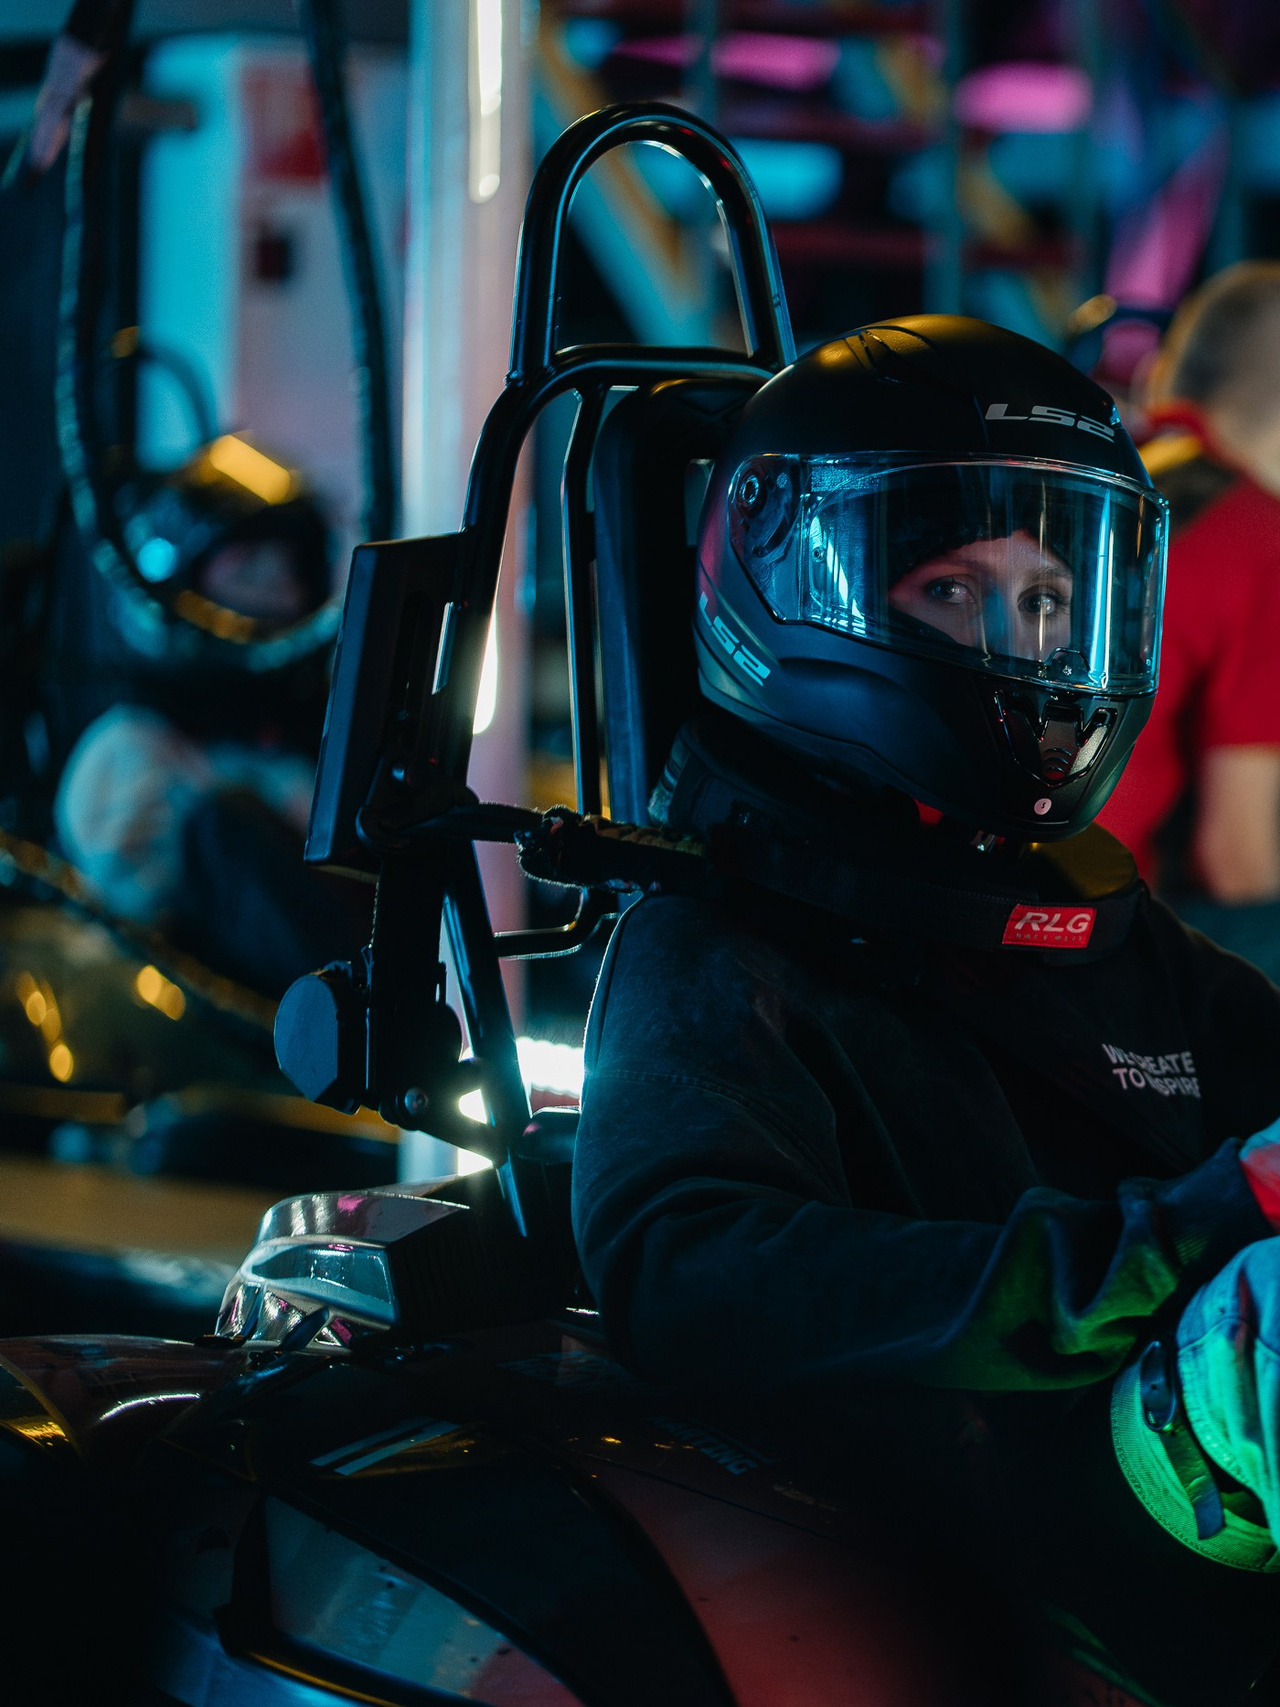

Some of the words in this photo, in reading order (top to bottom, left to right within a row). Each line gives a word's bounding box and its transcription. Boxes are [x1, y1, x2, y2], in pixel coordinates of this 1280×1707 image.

[985, 403, 1115, 443] LS2
[699, 591, 771, 686] LS2
[1014, 911, 1092, 933] RLG
[1112, 1067, 1147, 1090] TO
